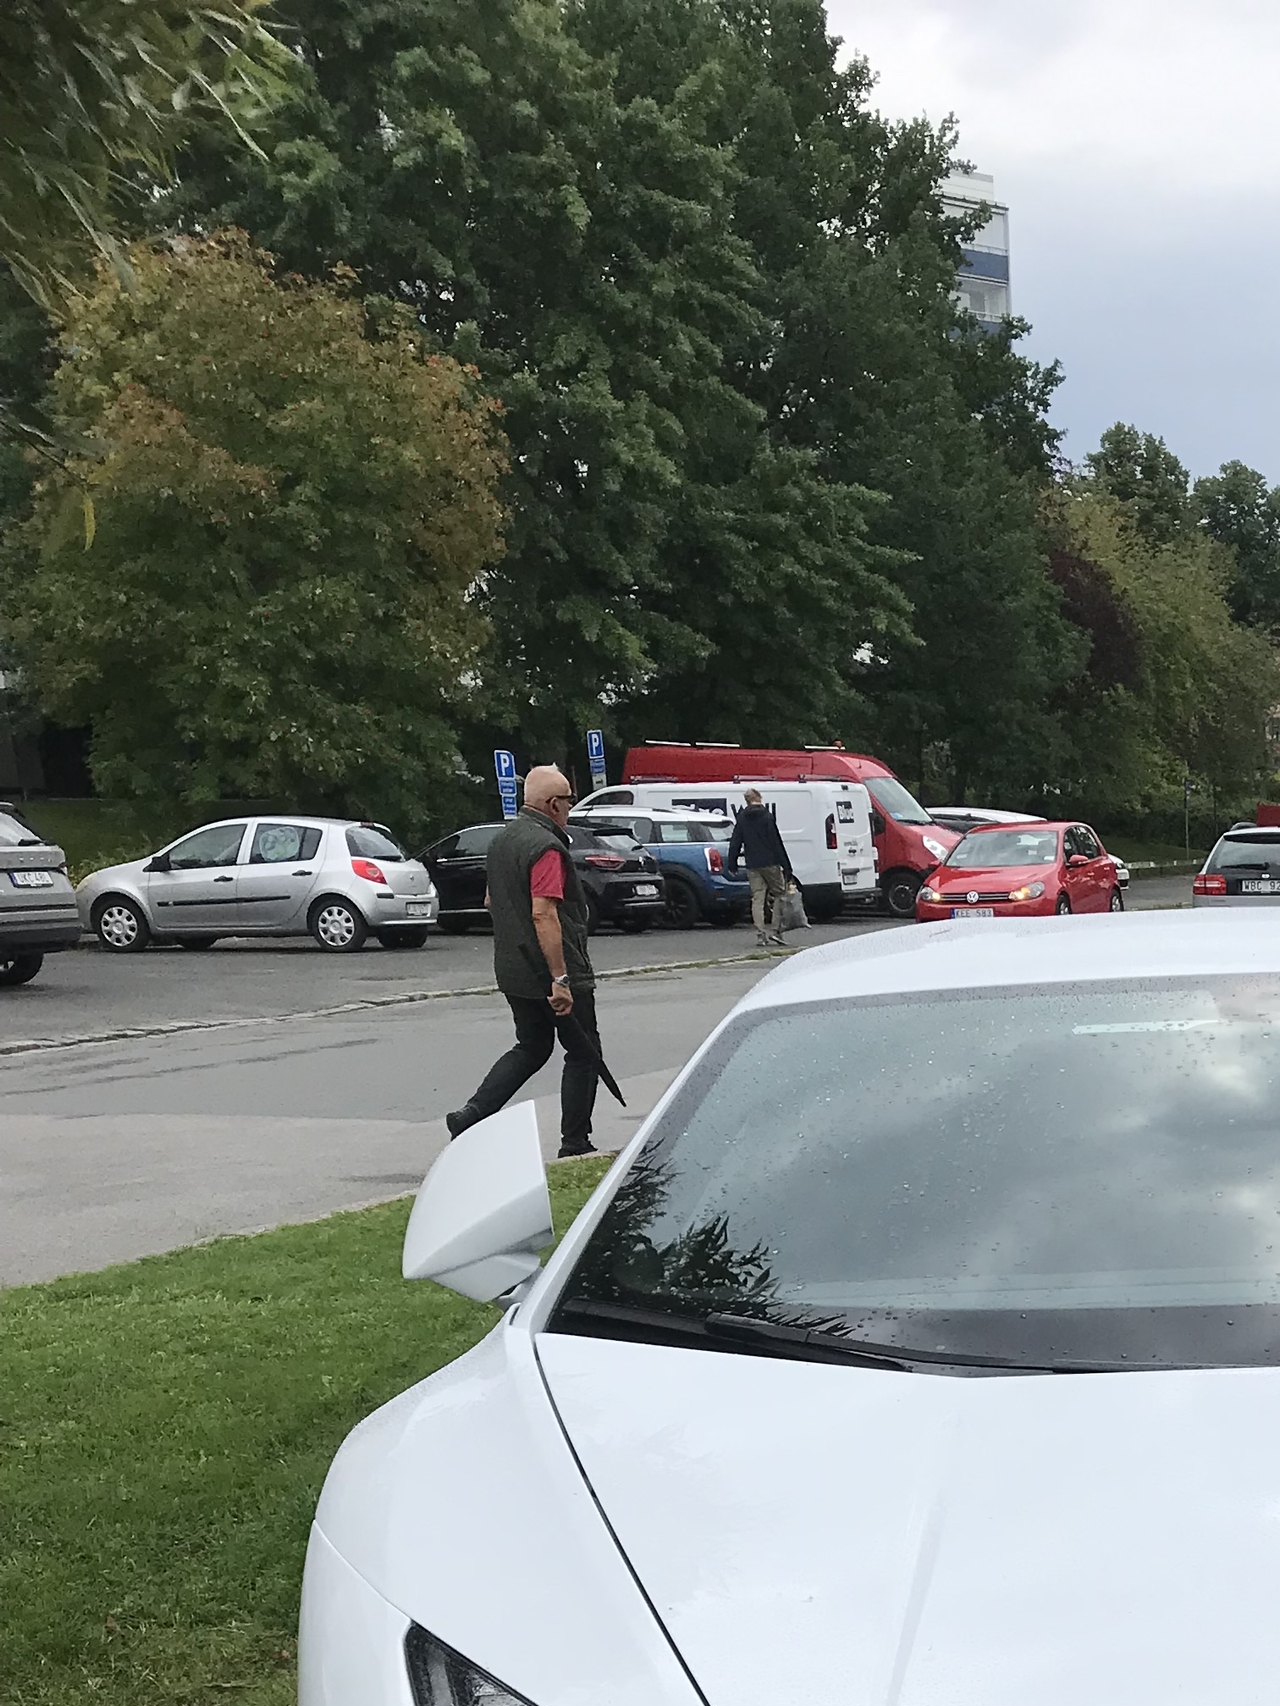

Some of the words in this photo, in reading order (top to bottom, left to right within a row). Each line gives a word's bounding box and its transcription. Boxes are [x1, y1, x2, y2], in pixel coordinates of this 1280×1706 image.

[591, 733, 600, 755] P
[500, 753, 510, 776] P
[1243, 881, 1263, 890] WBC
[956, 909, 971, 918] KEE
[975, 909, 992, 918] 583
